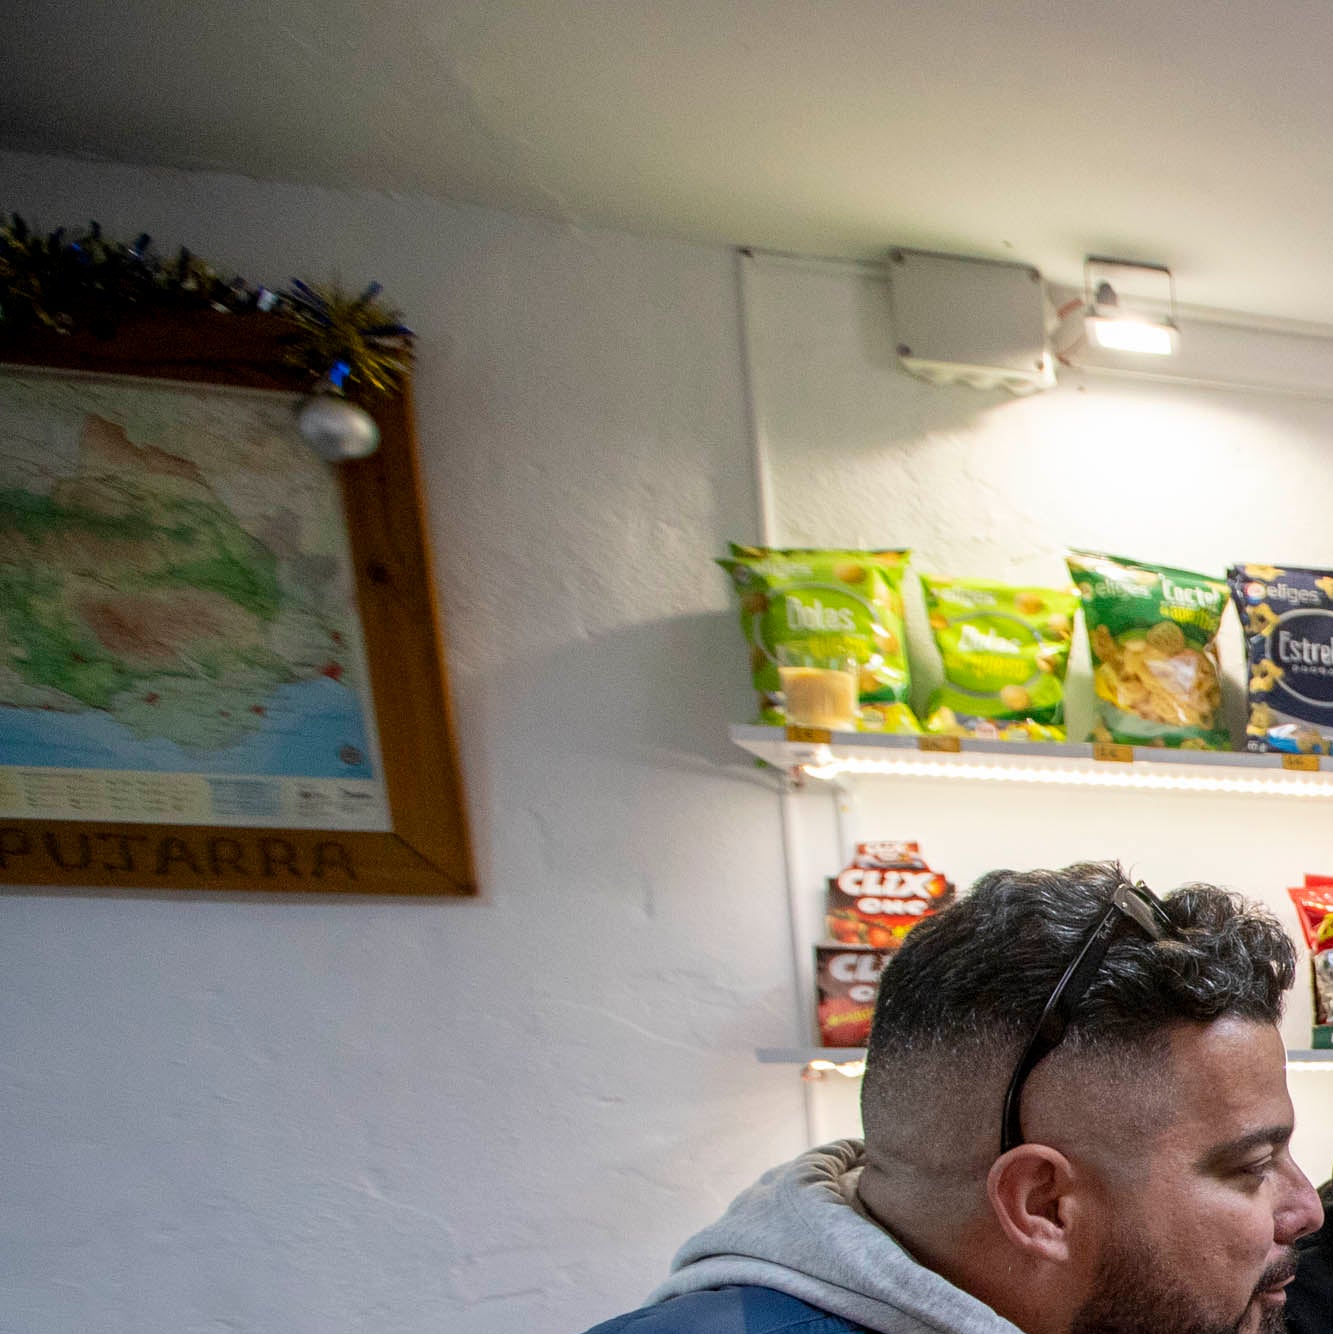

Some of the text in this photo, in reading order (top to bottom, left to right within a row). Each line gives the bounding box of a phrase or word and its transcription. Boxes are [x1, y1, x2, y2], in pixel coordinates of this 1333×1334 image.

[1267, 583, 1323, 605] eliges
[0, 826, 357, 881] PUJARRA
[857, 897, 928, 916] ONE
